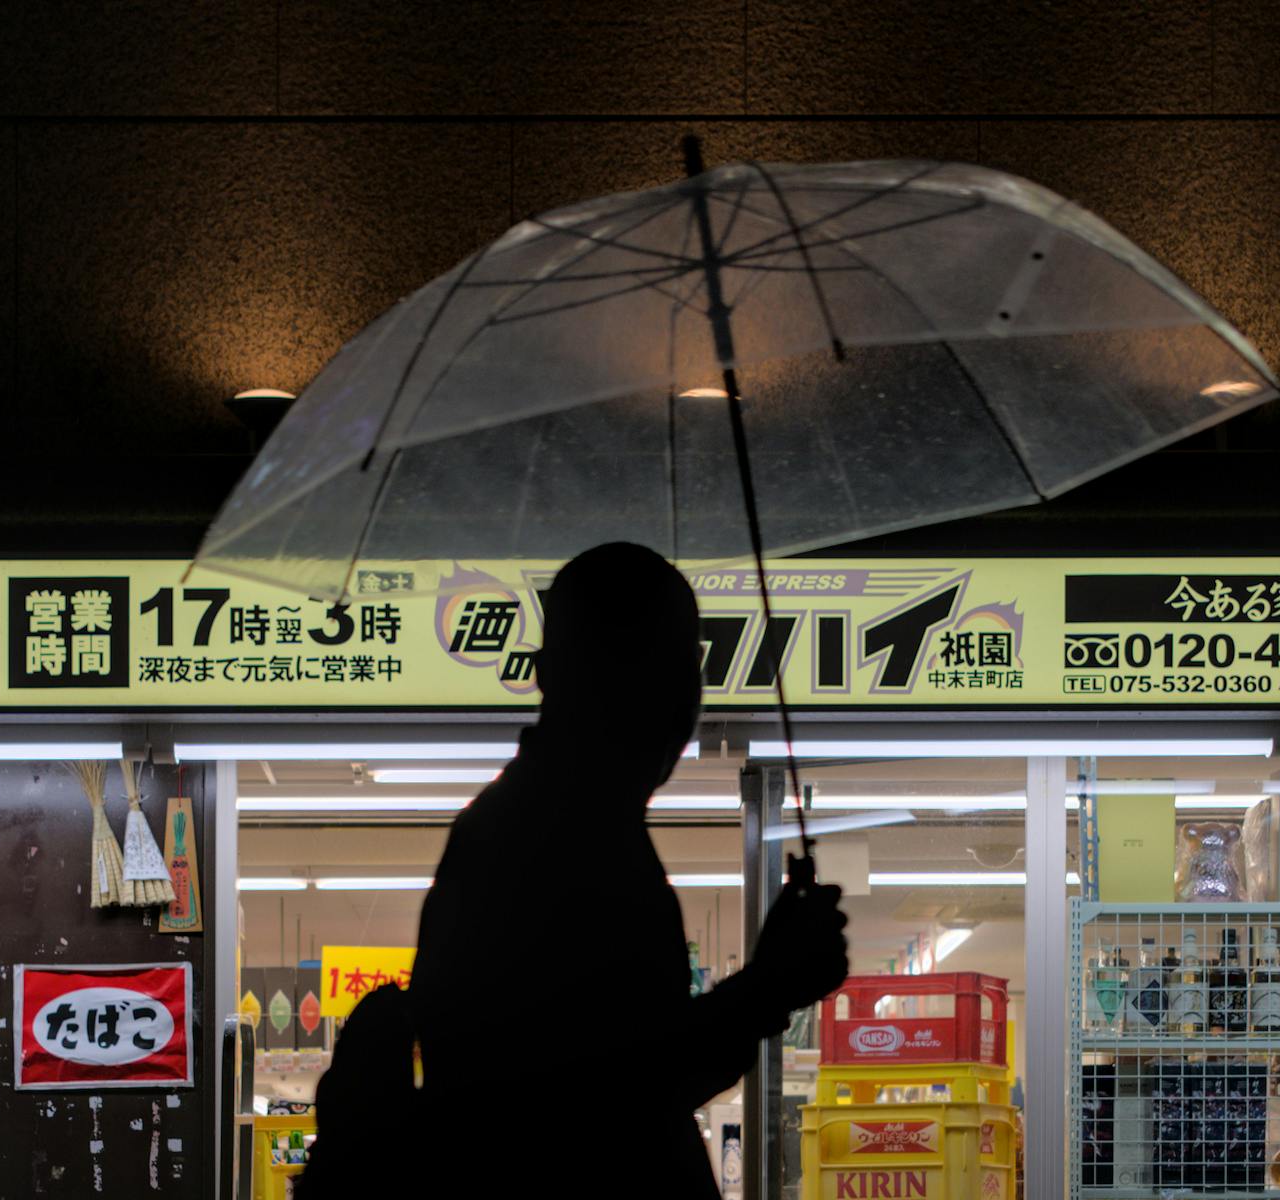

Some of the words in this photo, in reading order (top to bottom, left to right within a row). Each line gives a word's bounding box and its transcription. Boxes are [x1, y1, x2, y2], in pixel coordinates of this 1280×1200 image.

[24, 588, 114, 632] 営業
[24, 633, 114, 678] 時間
[940, 632, 1013, 668] 祇園
[139, 655, 403, 684] 深夜まで元気に営業中
[928, 670, 1024, 690] 中末吉町店
[1067, 678, 1103, 692] TEL
[1110, 675, 1272, 693] 075-532-0360
[46, 1002, 157, 1050] たばこ
[836, 1169, 927, 1200] KIRIN
